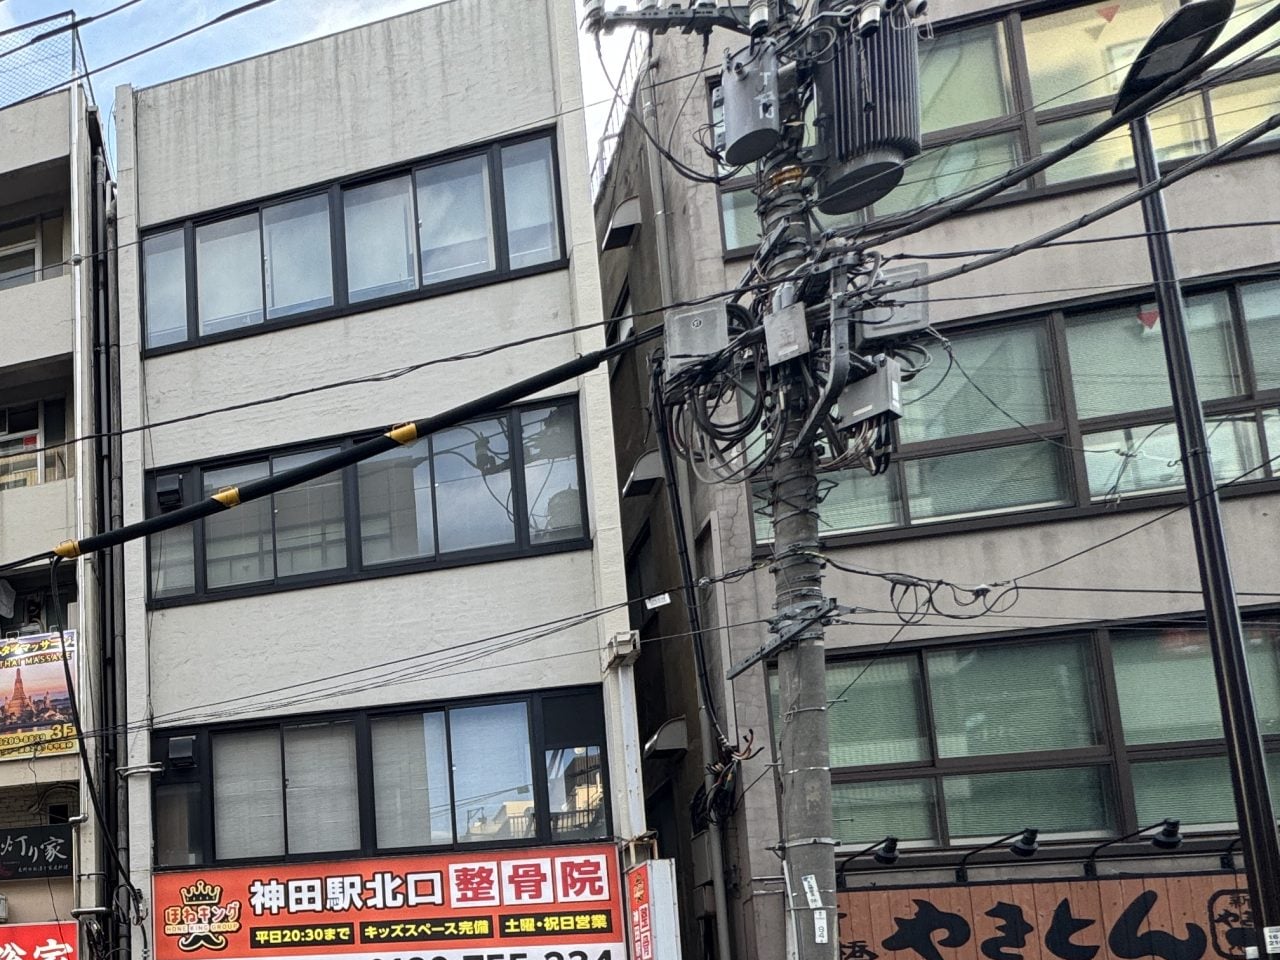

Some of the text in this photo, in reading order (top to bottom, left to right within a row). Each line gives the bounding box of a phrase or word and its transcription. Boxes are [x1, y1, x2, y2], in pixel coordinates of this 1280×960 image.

[50, 722, 74, 740] 3F
[0, 835, 68, 863] 灯り家
[250, 860, 604, 915] 神田駅北口 整骨院
[165, 901, 240, 924] ほねキング
[166, 923, 239, 933] HONE KING GROUP
[255, 914, 608, 944] 平日20:30まで キッズスペース完備 土曜・祝日営業
